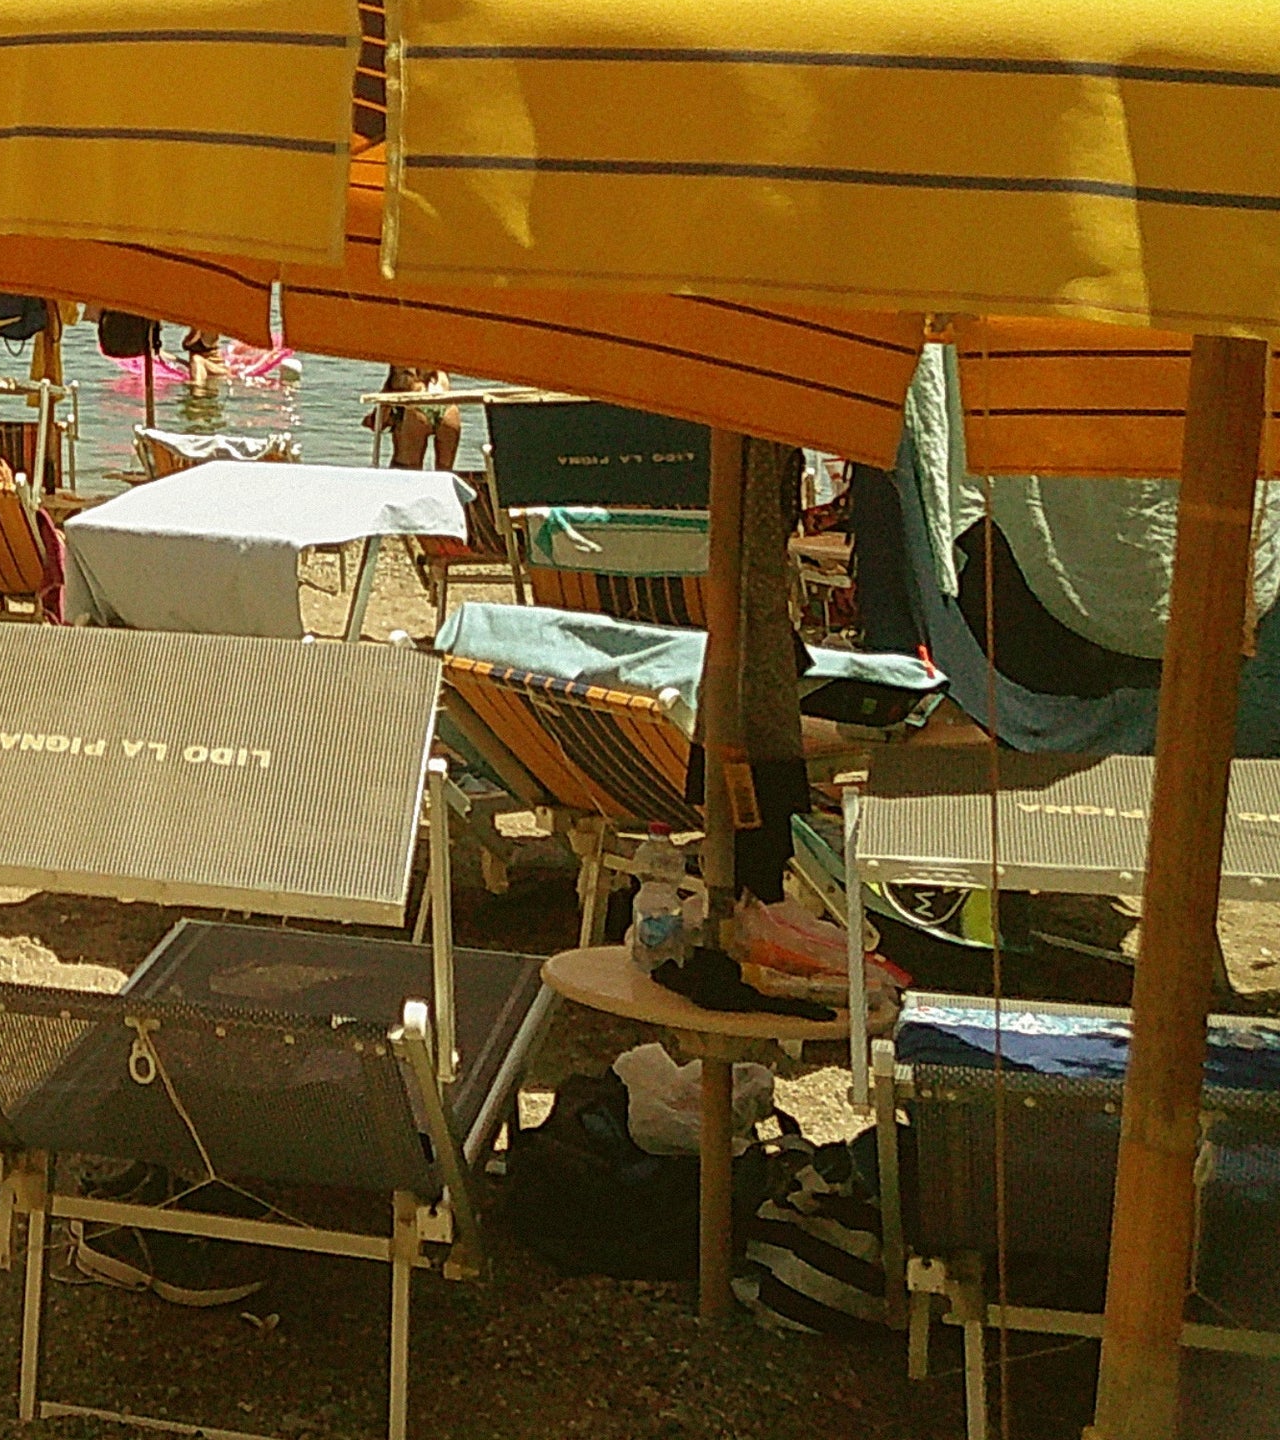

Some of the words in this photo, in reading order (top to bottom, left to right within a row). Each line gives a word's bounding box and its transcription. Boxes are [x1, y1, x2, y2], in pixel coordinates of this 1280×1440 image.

[0, 732, 106, 757] PIGNA
[121, 739, 167, 762] LA
[183, 745, 272, 769] LIDO
